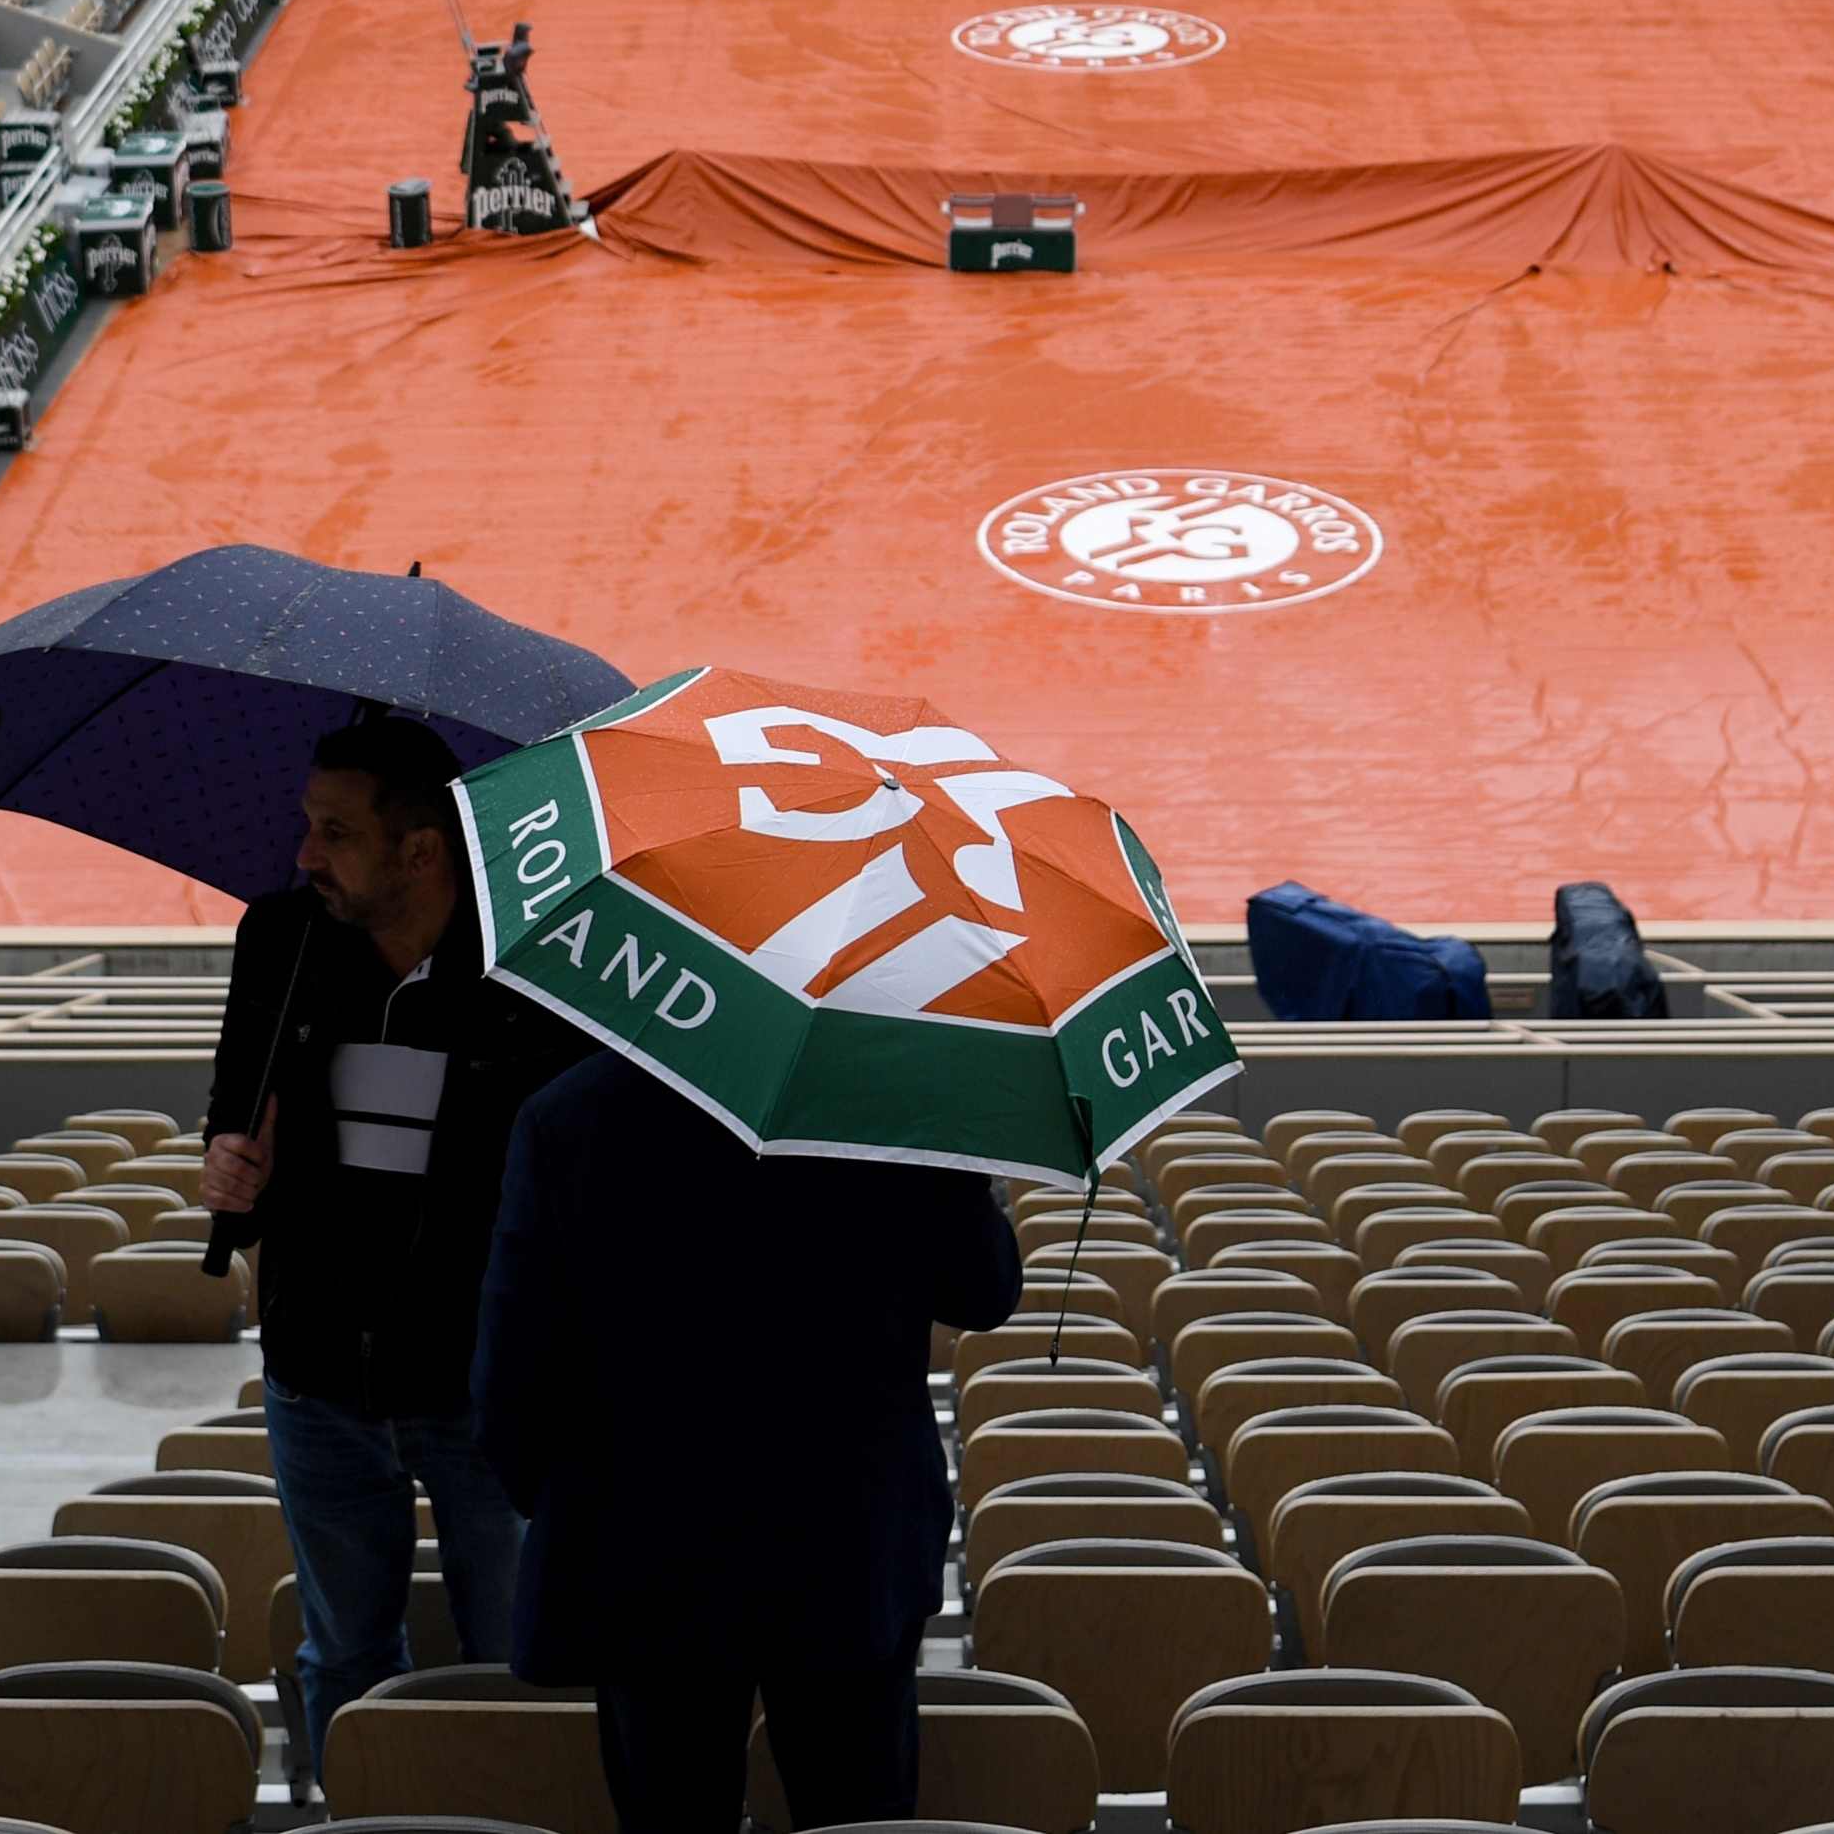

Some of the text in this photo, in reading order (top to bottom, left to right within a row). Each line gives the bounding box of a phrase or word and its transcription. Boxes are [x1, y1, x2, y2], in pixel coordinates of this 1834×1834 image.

[474, 179, 556, 228] perrier
[1003, 476, 1360, 556] ROLAND GARROS
[1063, 569, 1311, 603] PARIS
[509, 798, 717, 1030] ROLAND
